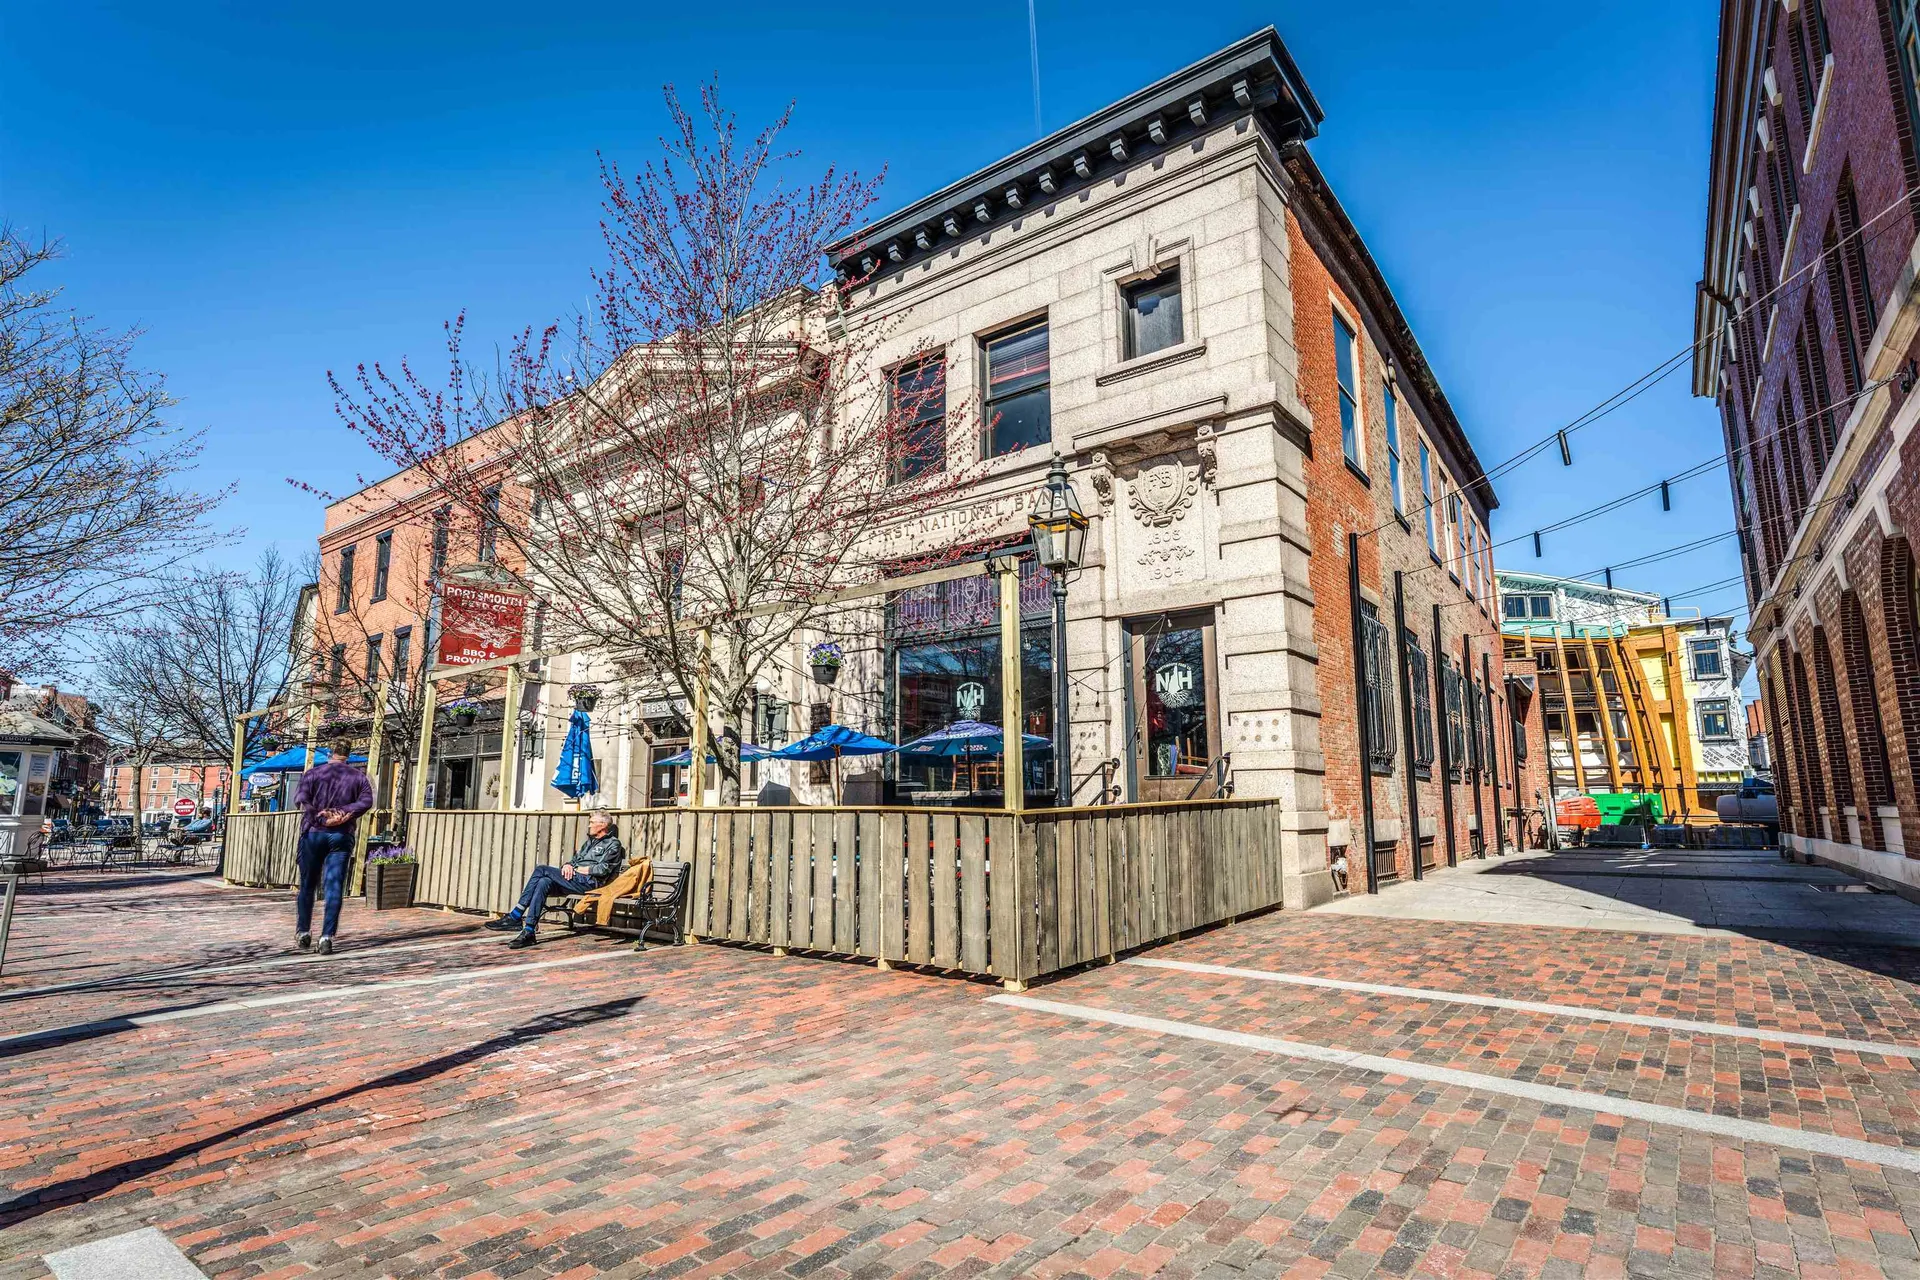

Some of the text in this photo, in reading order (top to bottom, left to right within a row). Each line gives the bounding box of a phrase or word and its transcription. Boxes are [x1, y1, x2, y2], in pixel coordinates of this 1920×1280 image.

[920, 503, 1005, 534] NATIONAL
[447, 586, 522, 607] PORTSMOUTH
[463, 648, 499, 659] BBQ &
[646, 701, 668, 714] FEED
